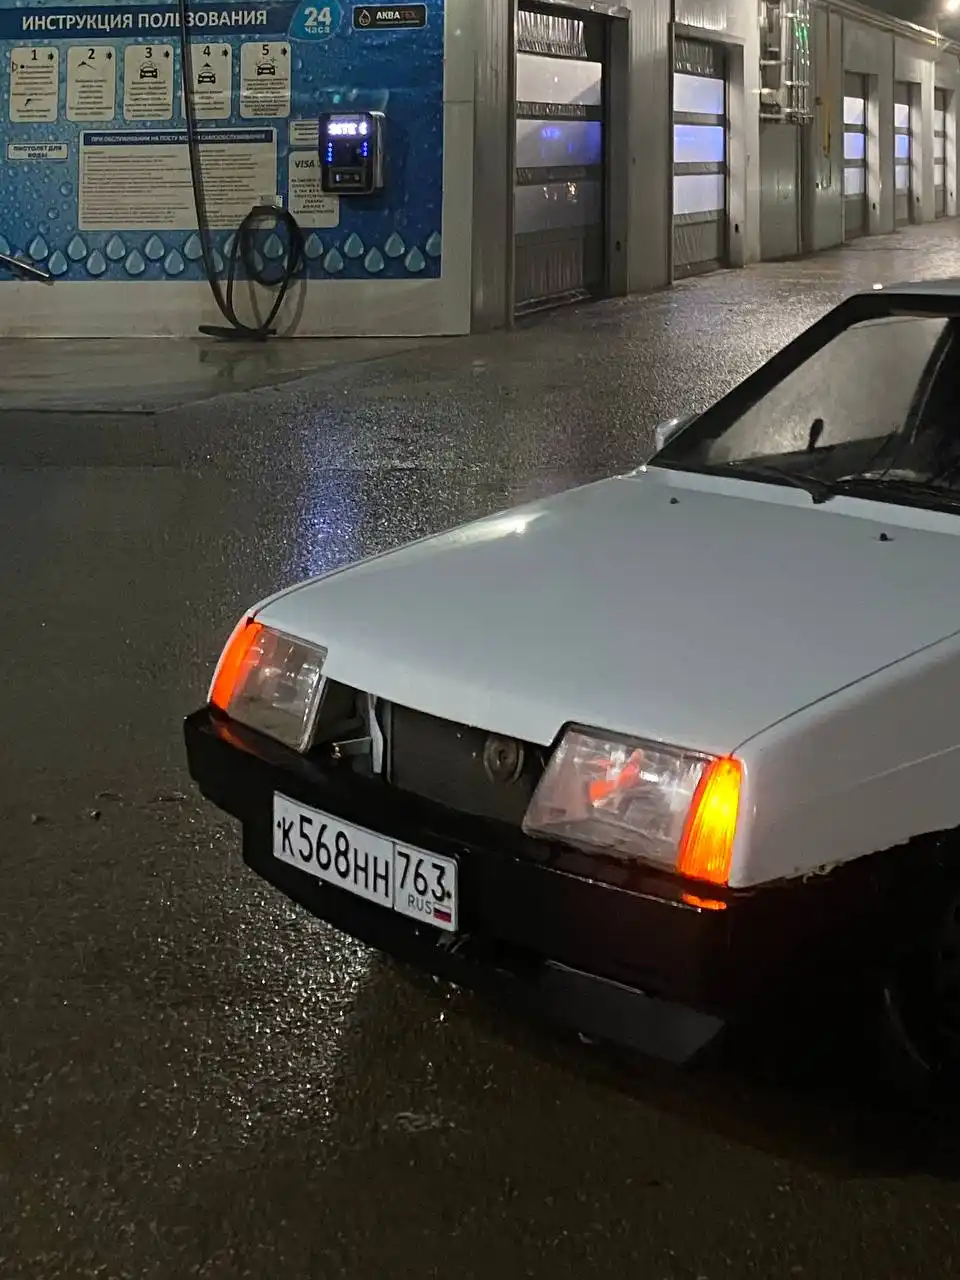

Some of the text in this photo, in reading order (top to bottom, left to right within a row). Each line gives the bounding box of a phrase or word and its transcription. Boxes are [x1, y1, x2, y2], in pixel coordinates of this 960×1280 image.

[22, 13, 133, 32] ИНСТРУКЦИЯ
[304, 7, 332, 26] 24
[31, 49, 38, 60] 1
[88, 48, 95, 60] 2
[145, 47, 152, 59] 3
[203, 45, 211, 57] 4
[262, 44, 269, 56] 5
[295, 160, 315, 168] VISA
[281, 814, 446, 902] К568НН 763
[407, 894, 432, 915] RUS
